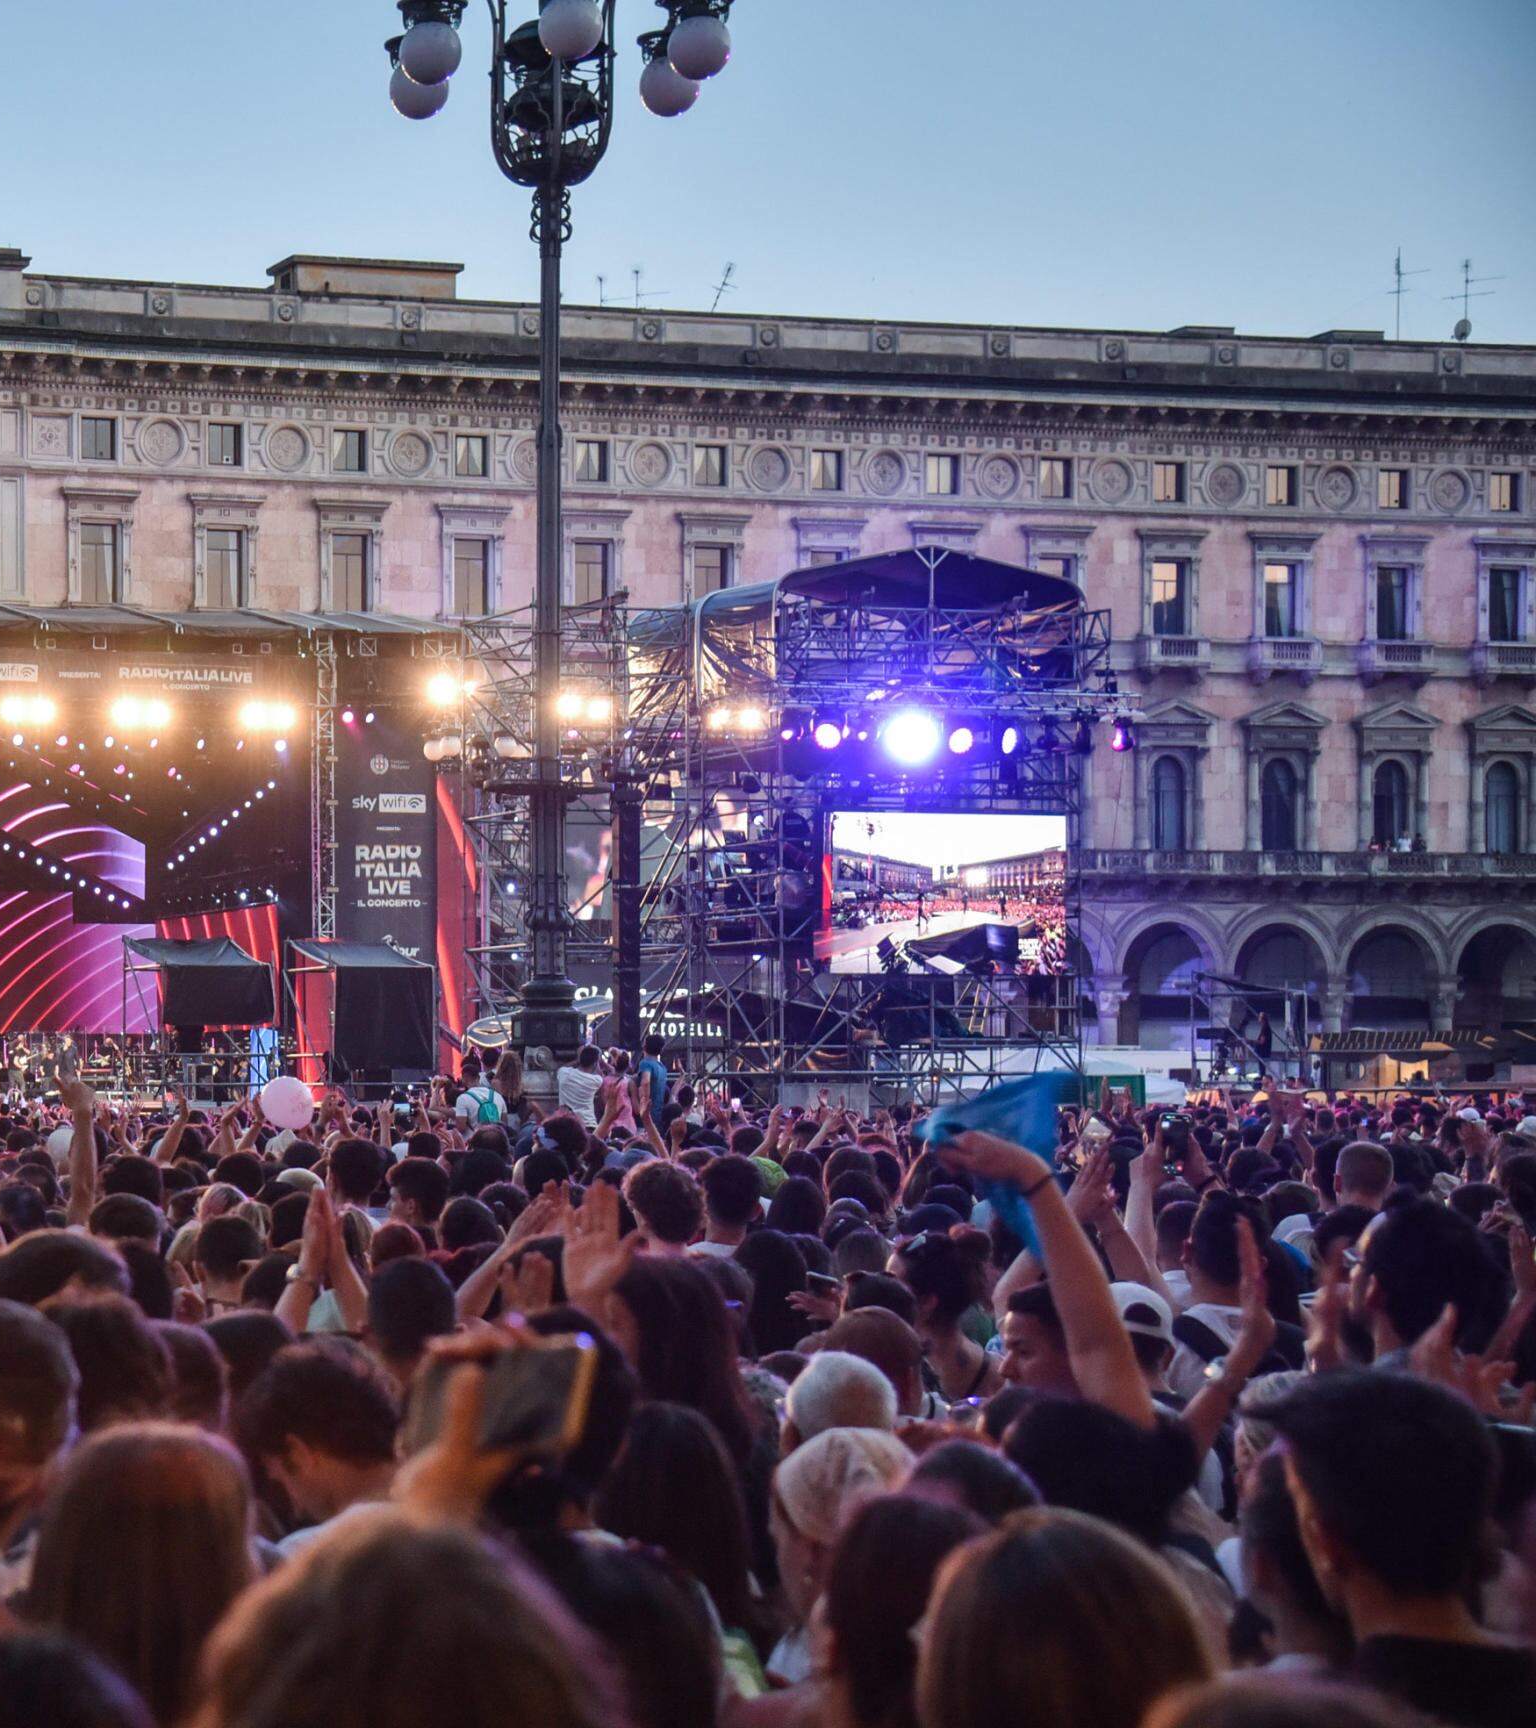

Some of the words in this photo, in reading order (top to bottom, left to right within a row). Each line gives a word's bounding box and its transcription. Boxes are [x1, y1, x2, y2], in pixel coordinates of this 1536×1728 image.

[352, 795, 377, 812] sky
[382, 796, 407, 808] wifi
[355, 844, 422, 861] RADIO
[355, 862, 422, 878] ITALIA
[368, 880, 411, 895] LIVE
[367, 899, 421, 908] CONCERTO
